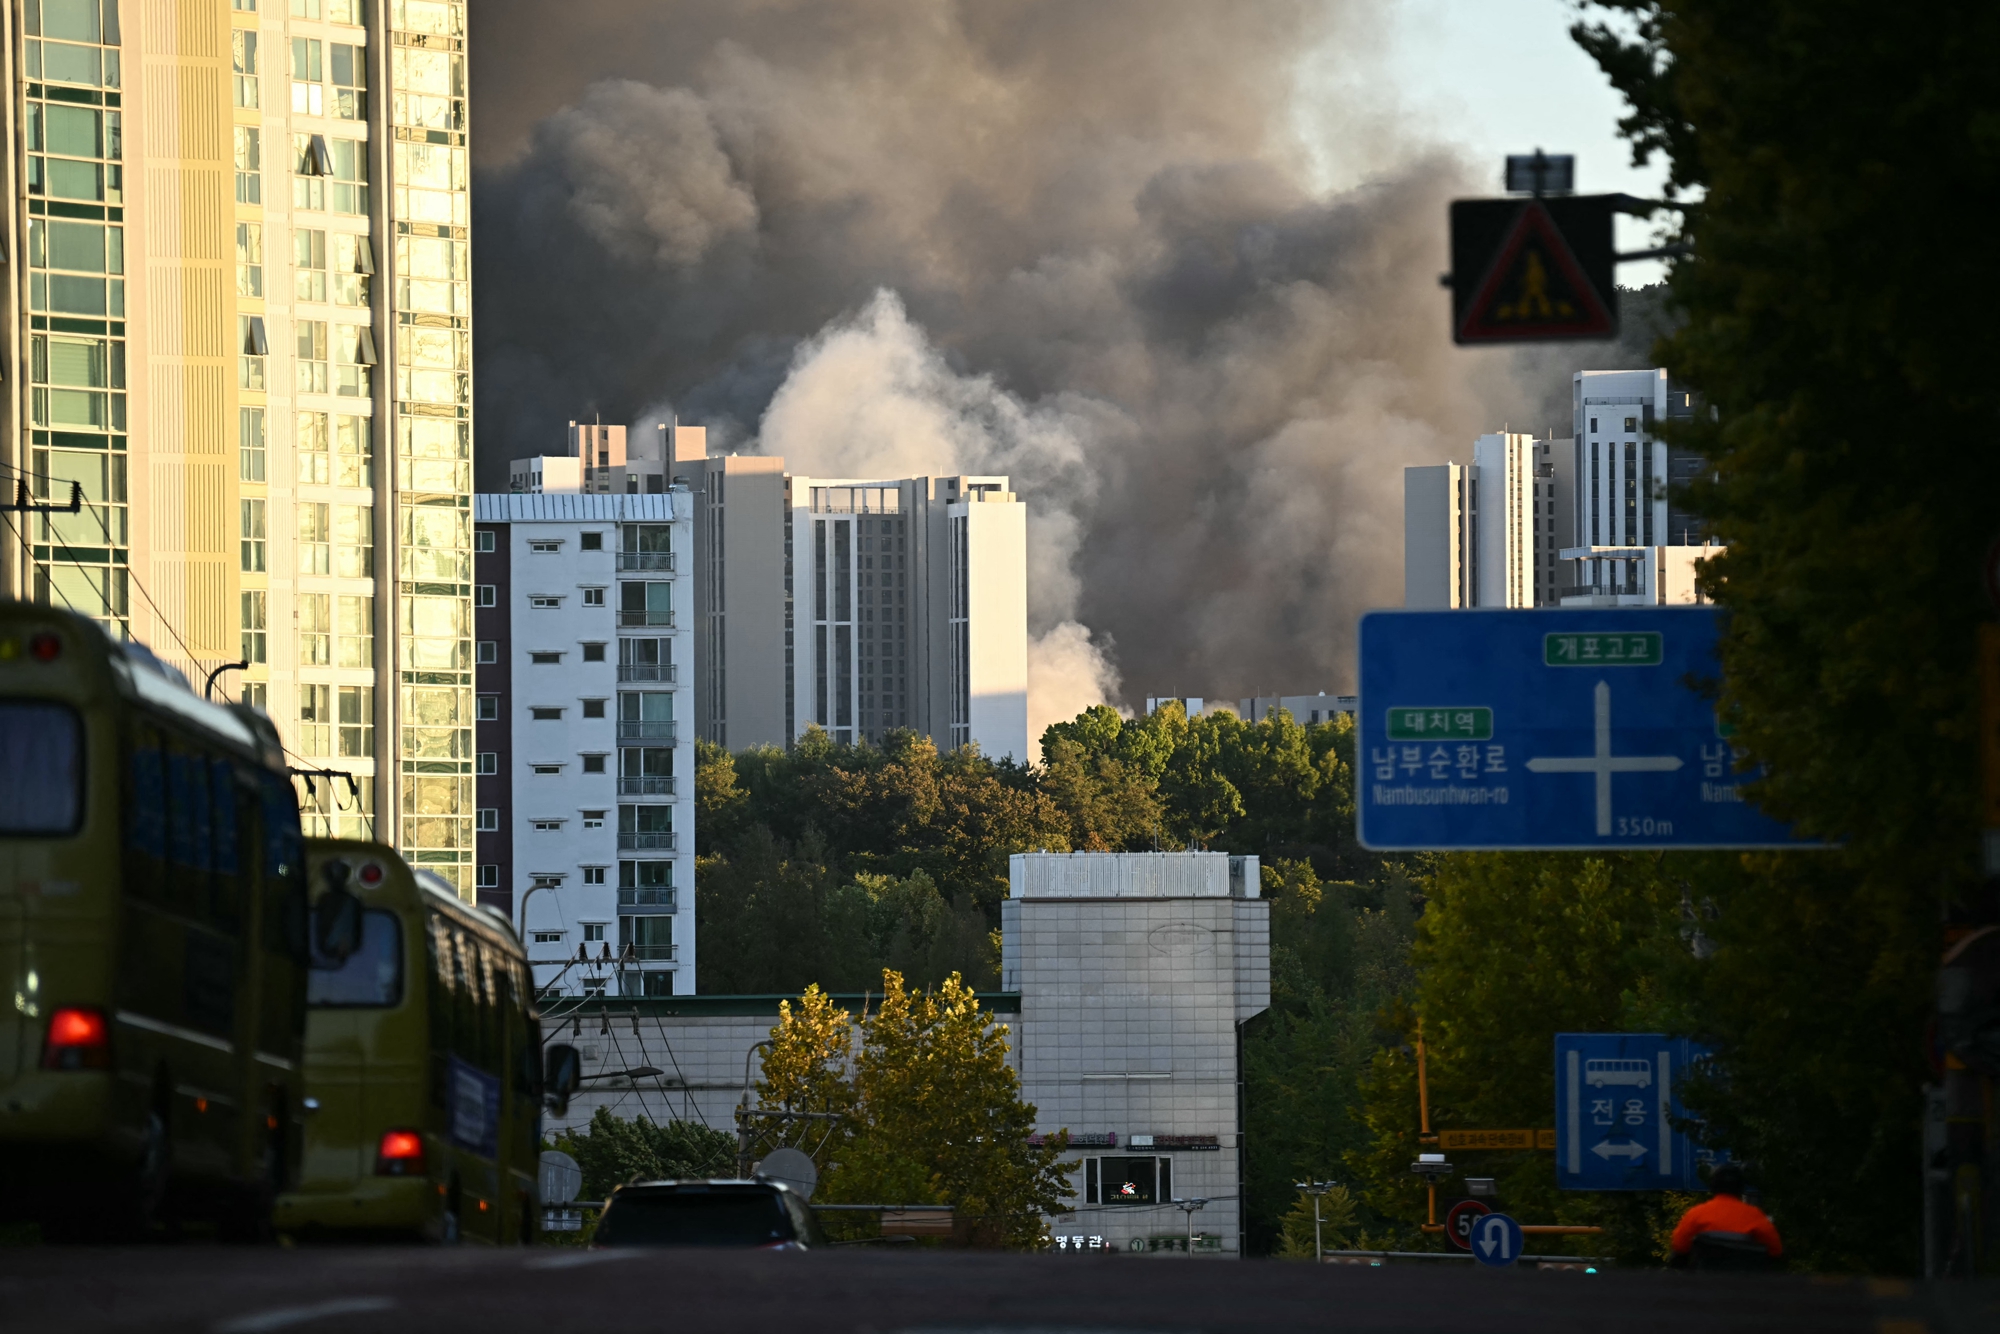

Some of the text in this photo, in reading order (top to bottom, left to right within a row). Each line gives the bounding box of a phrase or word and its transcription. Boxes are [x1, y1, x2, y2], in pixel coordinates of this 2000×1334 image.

[1557, 636, 1649, 660] 개포고교
[1404, 711, 1475, 735] 대치역
[1372, 744, 1509, 780] 남부순환로
[1373, 783, 1509, 806] Nambusunhwan-ro
[1618, 816, 1674, 837] 350m
